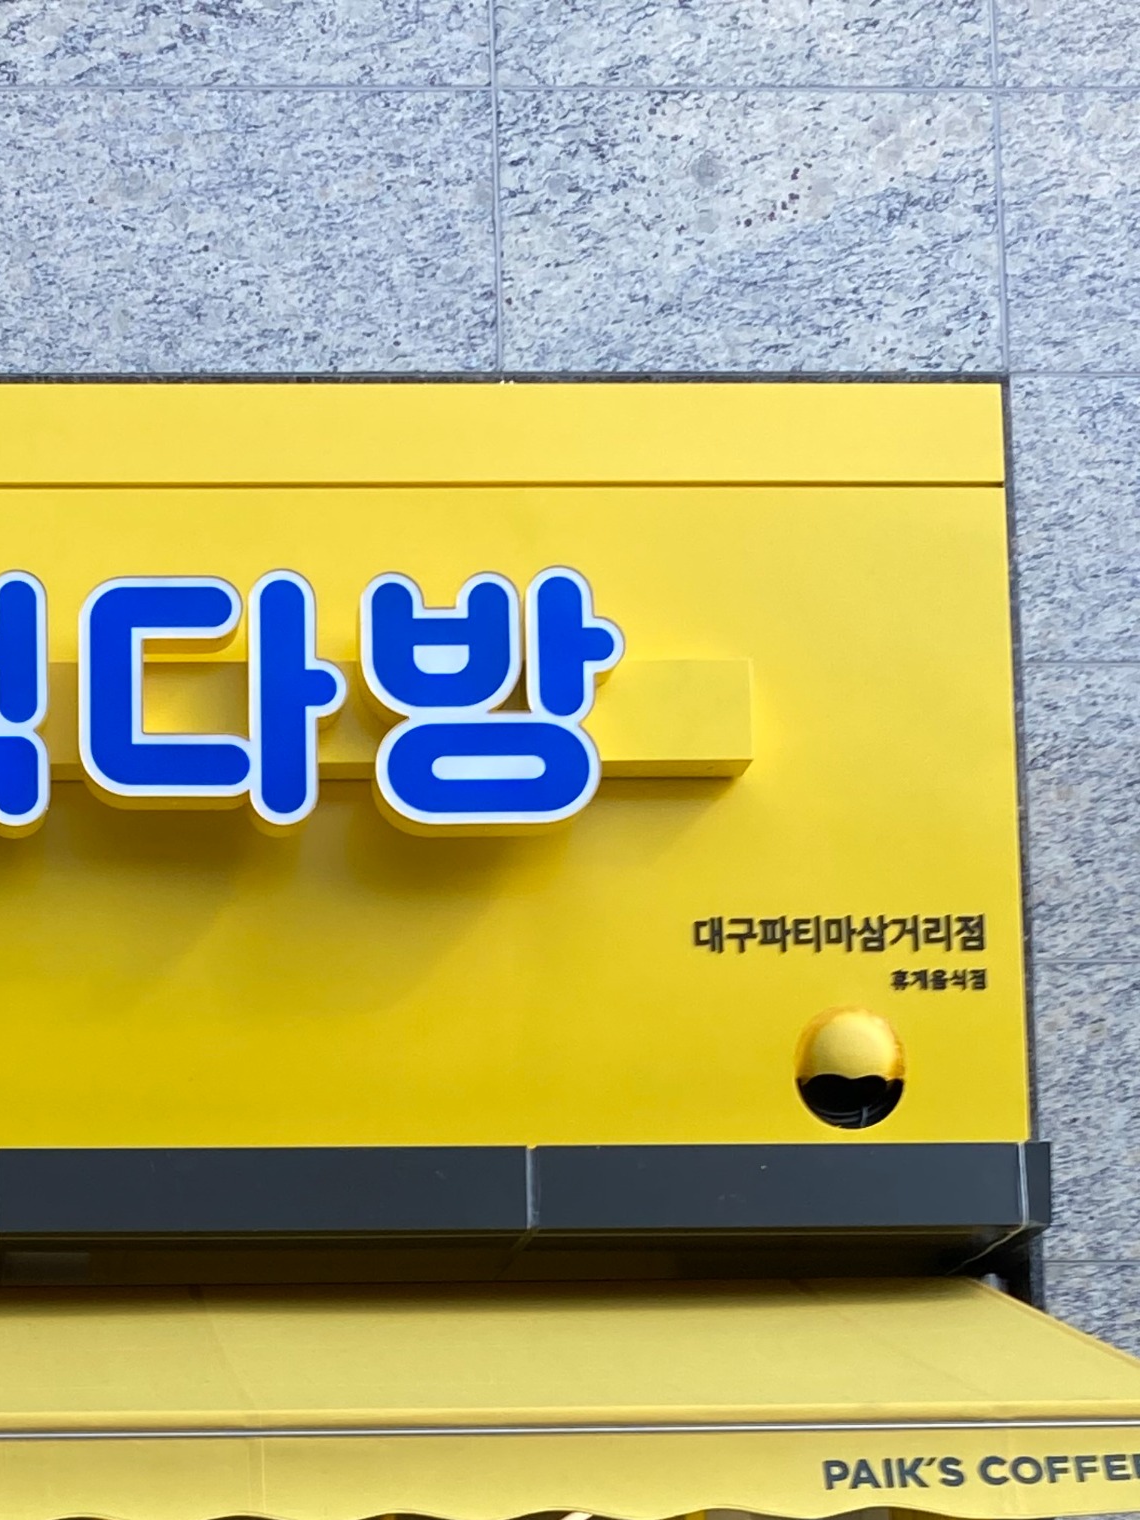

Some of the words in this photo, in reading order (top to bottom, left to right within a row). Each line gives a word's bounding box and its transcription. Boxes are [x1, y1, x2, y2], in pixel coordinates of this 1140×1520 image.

[693, 914, 987, 953] 대구파티마삼거리점
[890, 968, 988, 991] 휴게음식점
[822, 1456, 966, 1491] PAIK'S
